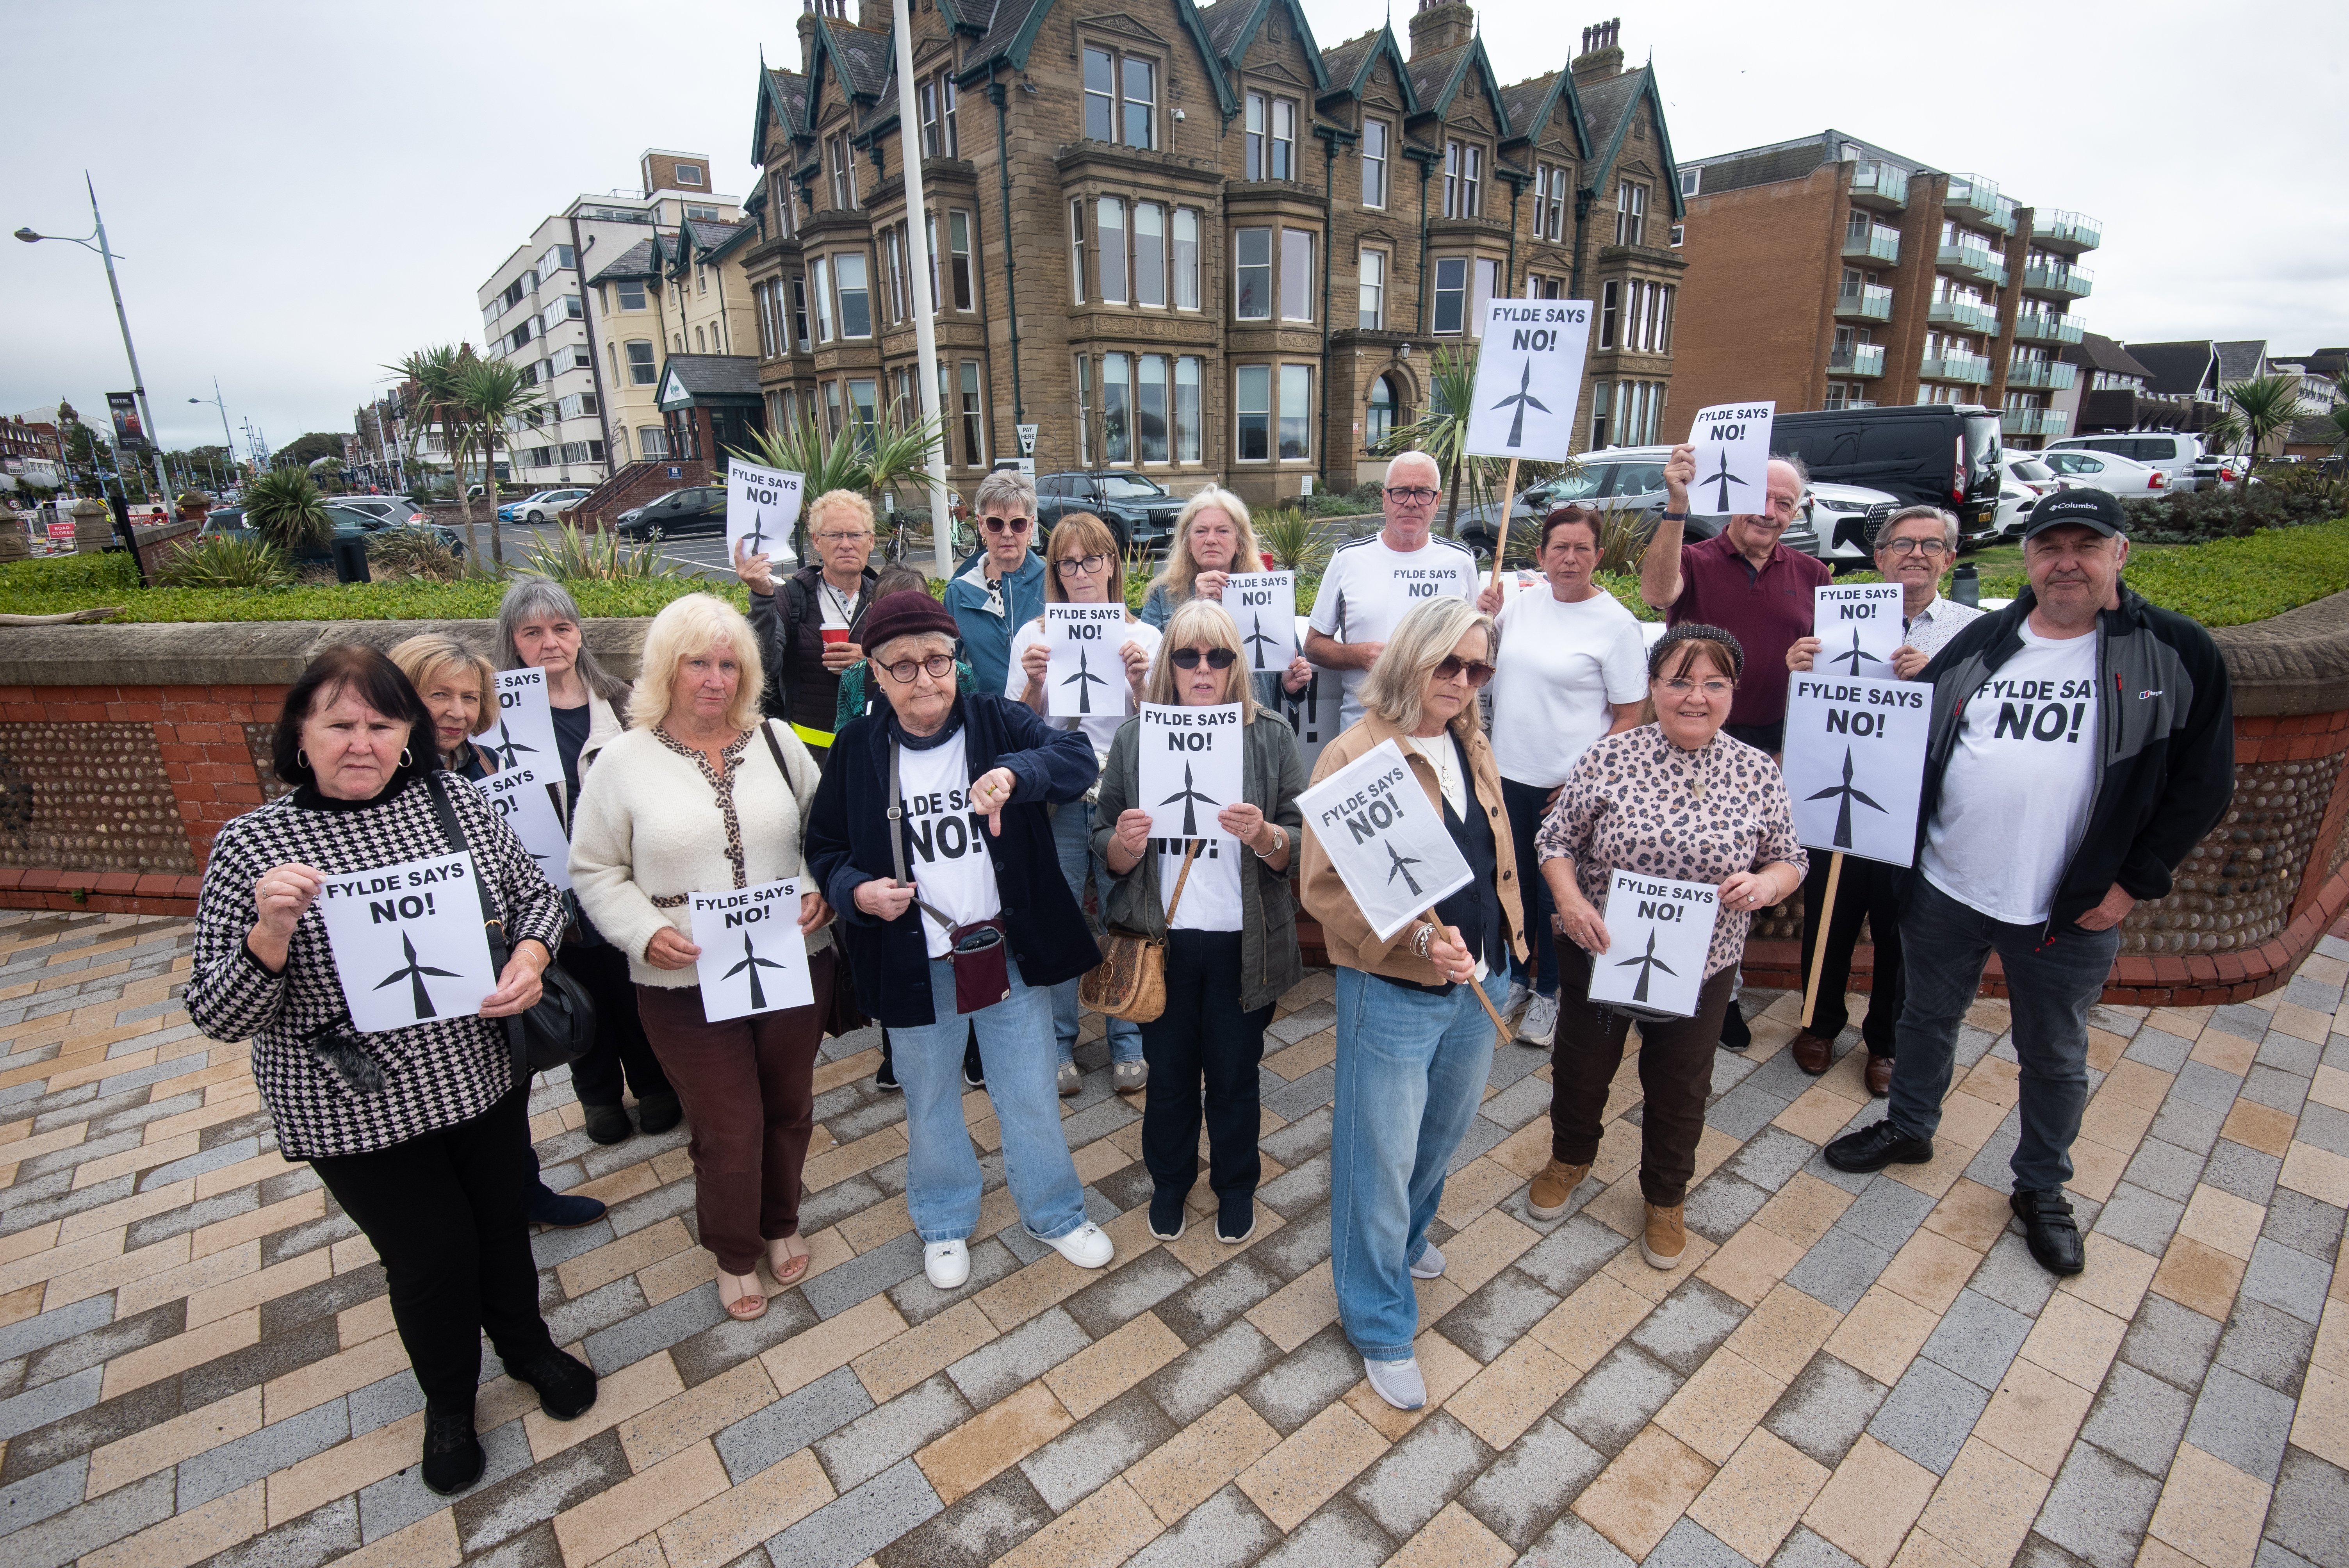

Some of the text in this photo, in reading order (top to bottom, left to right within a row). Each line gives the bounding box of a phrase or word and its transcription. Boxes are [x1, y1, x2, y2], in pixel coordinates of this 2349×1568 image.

[1493, 308, 1585, 323] FYLDE SAYS
[1512, 329, 1557, 351] NO!
[1698, 408, 1768, 422] FYLDE SAYS
[1710, 424, 1746, 440] NO!
[733, 468, 797, 490] FYLDE SAYS
[747, 486, 778, 506] NO!
[1225, 577, 1288, 588] FYLDE SAYS
[1394, 570, 1456, 579] FYLDE SAYS
[1242, 591, 1271, 606] NO!
[1409, 583, 1438, 597] NO!
[1821, 589, 1898, 600] FYLDE SAYS
[1050, 609, 1120, 619] FYLDE SAYS
[1840, 604, 1876, 619] NO!
[1068, 624, 1101, 640] NO!
[505, 674, 540, 687] SAYS
[1977, 679, 2097, 700] FYLDE SA
[499, 691, 521, 709] O!
[1798, 682, 1923, 708] FYLDE SAYS
[1145, 710, 1237, 726] FYLDE SAYS
[1826, 708, 1885, 738] NO!
[1994, 702, 2086, 743] NO!
[1169, 732, 1212, 751] NO!
[493, 770, 534, 792] SAYS
[492, 794, 519, 817] O!
[902, 793, 943, 818] LDE
[1321, 767, 1404, 827] FYLDE SAYS
[1346, 791, 1405, 845] NO!
[909, 812, 982, 866] NO!
[326, 863, 464, 899] FYLDE SAYS
[1617, 877, 1713, 903] FYLDE SAYS
[369, 892, 436, 924] NO!
[696, 885, 794, 910] FYLDE SAYS
[725, 905, 770, 929] NO!
[1637, 900, 1684, 923] NO!
